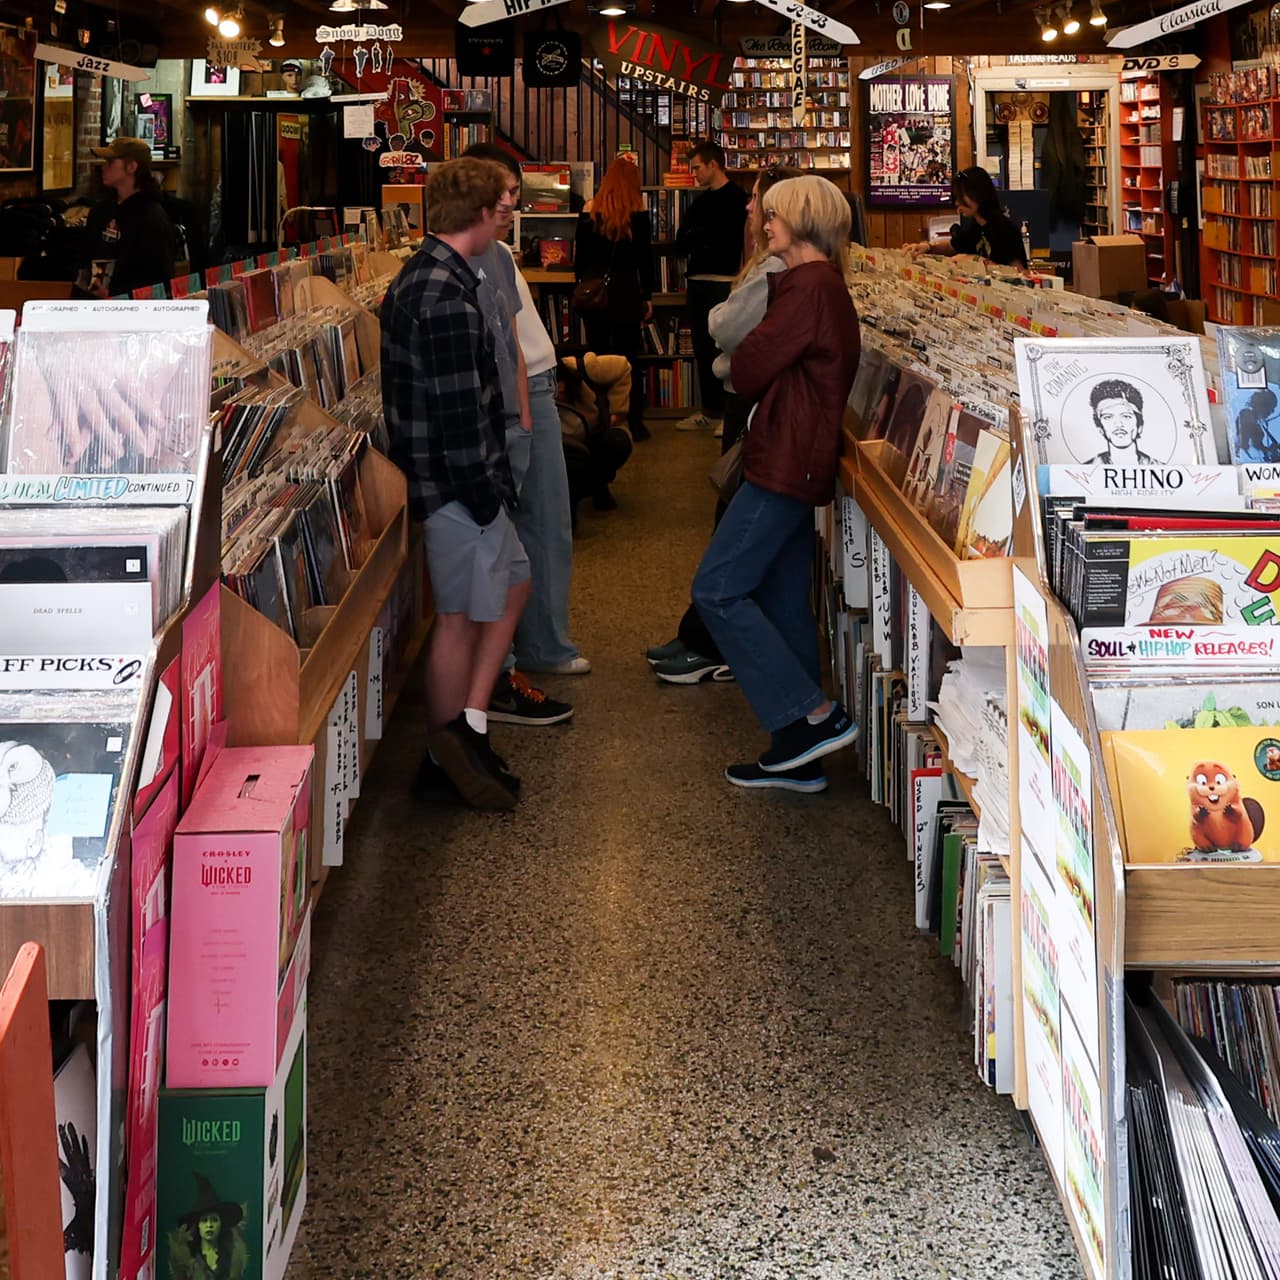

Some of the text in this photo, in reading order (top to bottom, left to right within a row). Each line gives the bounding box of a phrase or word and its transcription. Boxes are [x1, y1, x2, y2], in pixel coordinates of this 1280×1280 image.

[77, 55, 110, 73] Jazz
[609, 20, 732, 90] VINYL
[620, 61, 711, 102] UPSTAIRS
[870, 83, 950, 112] MOTHER LOVE BONE
[55, 477, 128, 499] LIMITED
[128, 482, 181, 493] CONTINUED
[1104, 468, 1183, 489] RHINO
[1149, 629, 1195, 639] NEW
[37, 657, 114, 672] PICKS
[1255, 700, 1272, 709] SON
[201, 863, 251, 887] WICKED
[183, 1117, 241, 1146] WICKED
